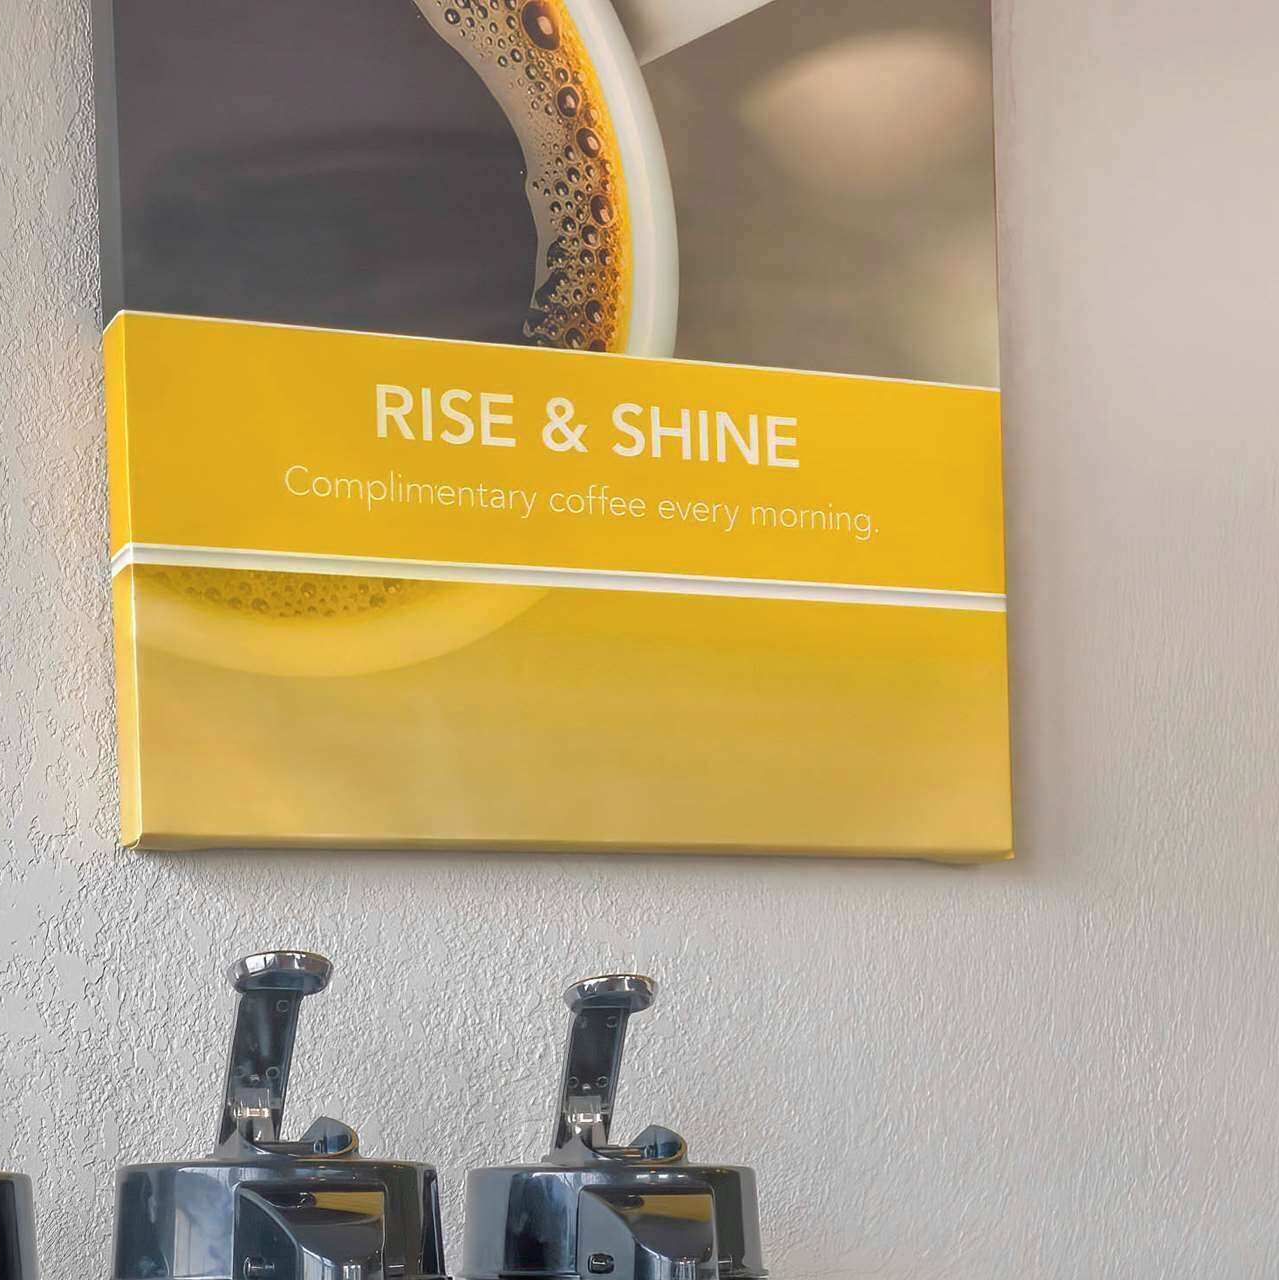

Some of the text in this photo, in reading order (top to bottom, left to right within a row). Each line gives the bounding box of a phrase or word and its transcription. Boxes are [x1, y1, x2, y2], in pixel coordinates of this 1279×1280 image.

[376, 384, 799, 467] RISE & SHINE
[284, 464, 879, 540] Complimentary coffee every morning.
